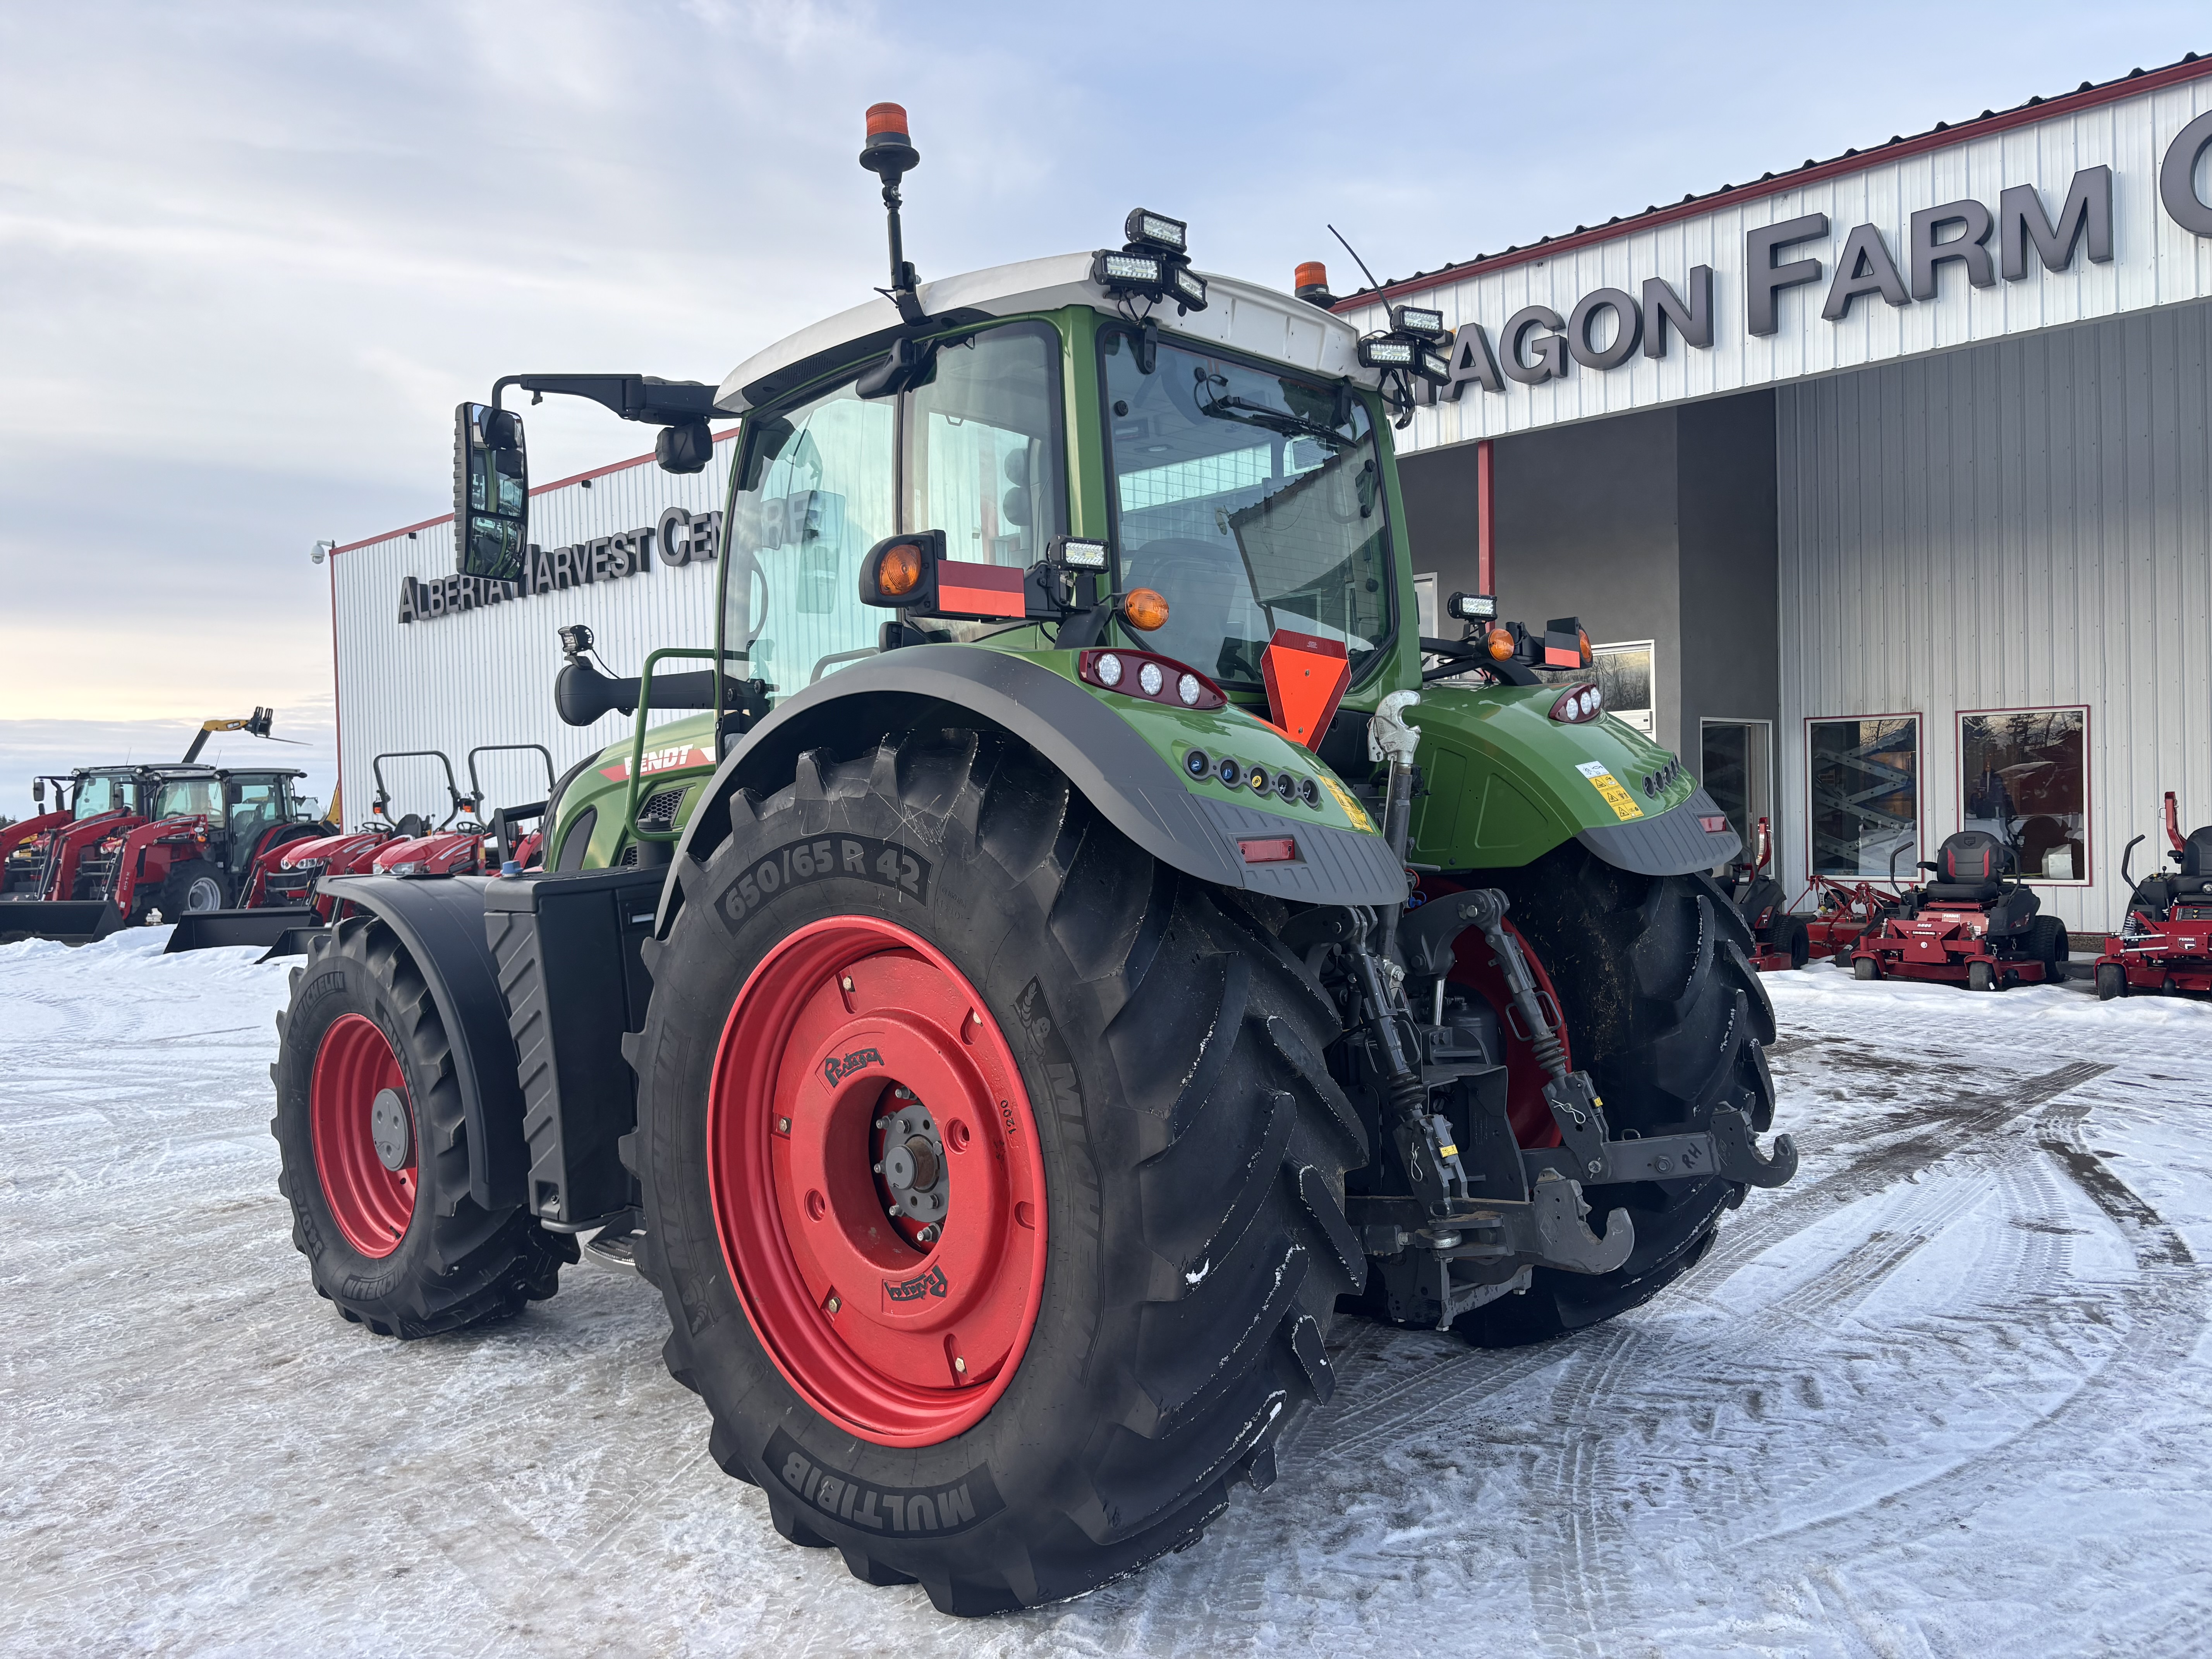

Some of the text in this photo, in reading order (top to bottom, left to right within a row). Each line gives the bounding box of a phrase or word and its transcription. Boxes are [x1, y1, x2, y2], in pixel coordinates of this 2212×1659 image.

[1747, 164, 2114, 338] FARM
[725, 840, 920, 920] 650/65 R 42
[1682, 1142, 1702, 1170] RH
[782, 1451, 976, 1532] MULTIBIB
